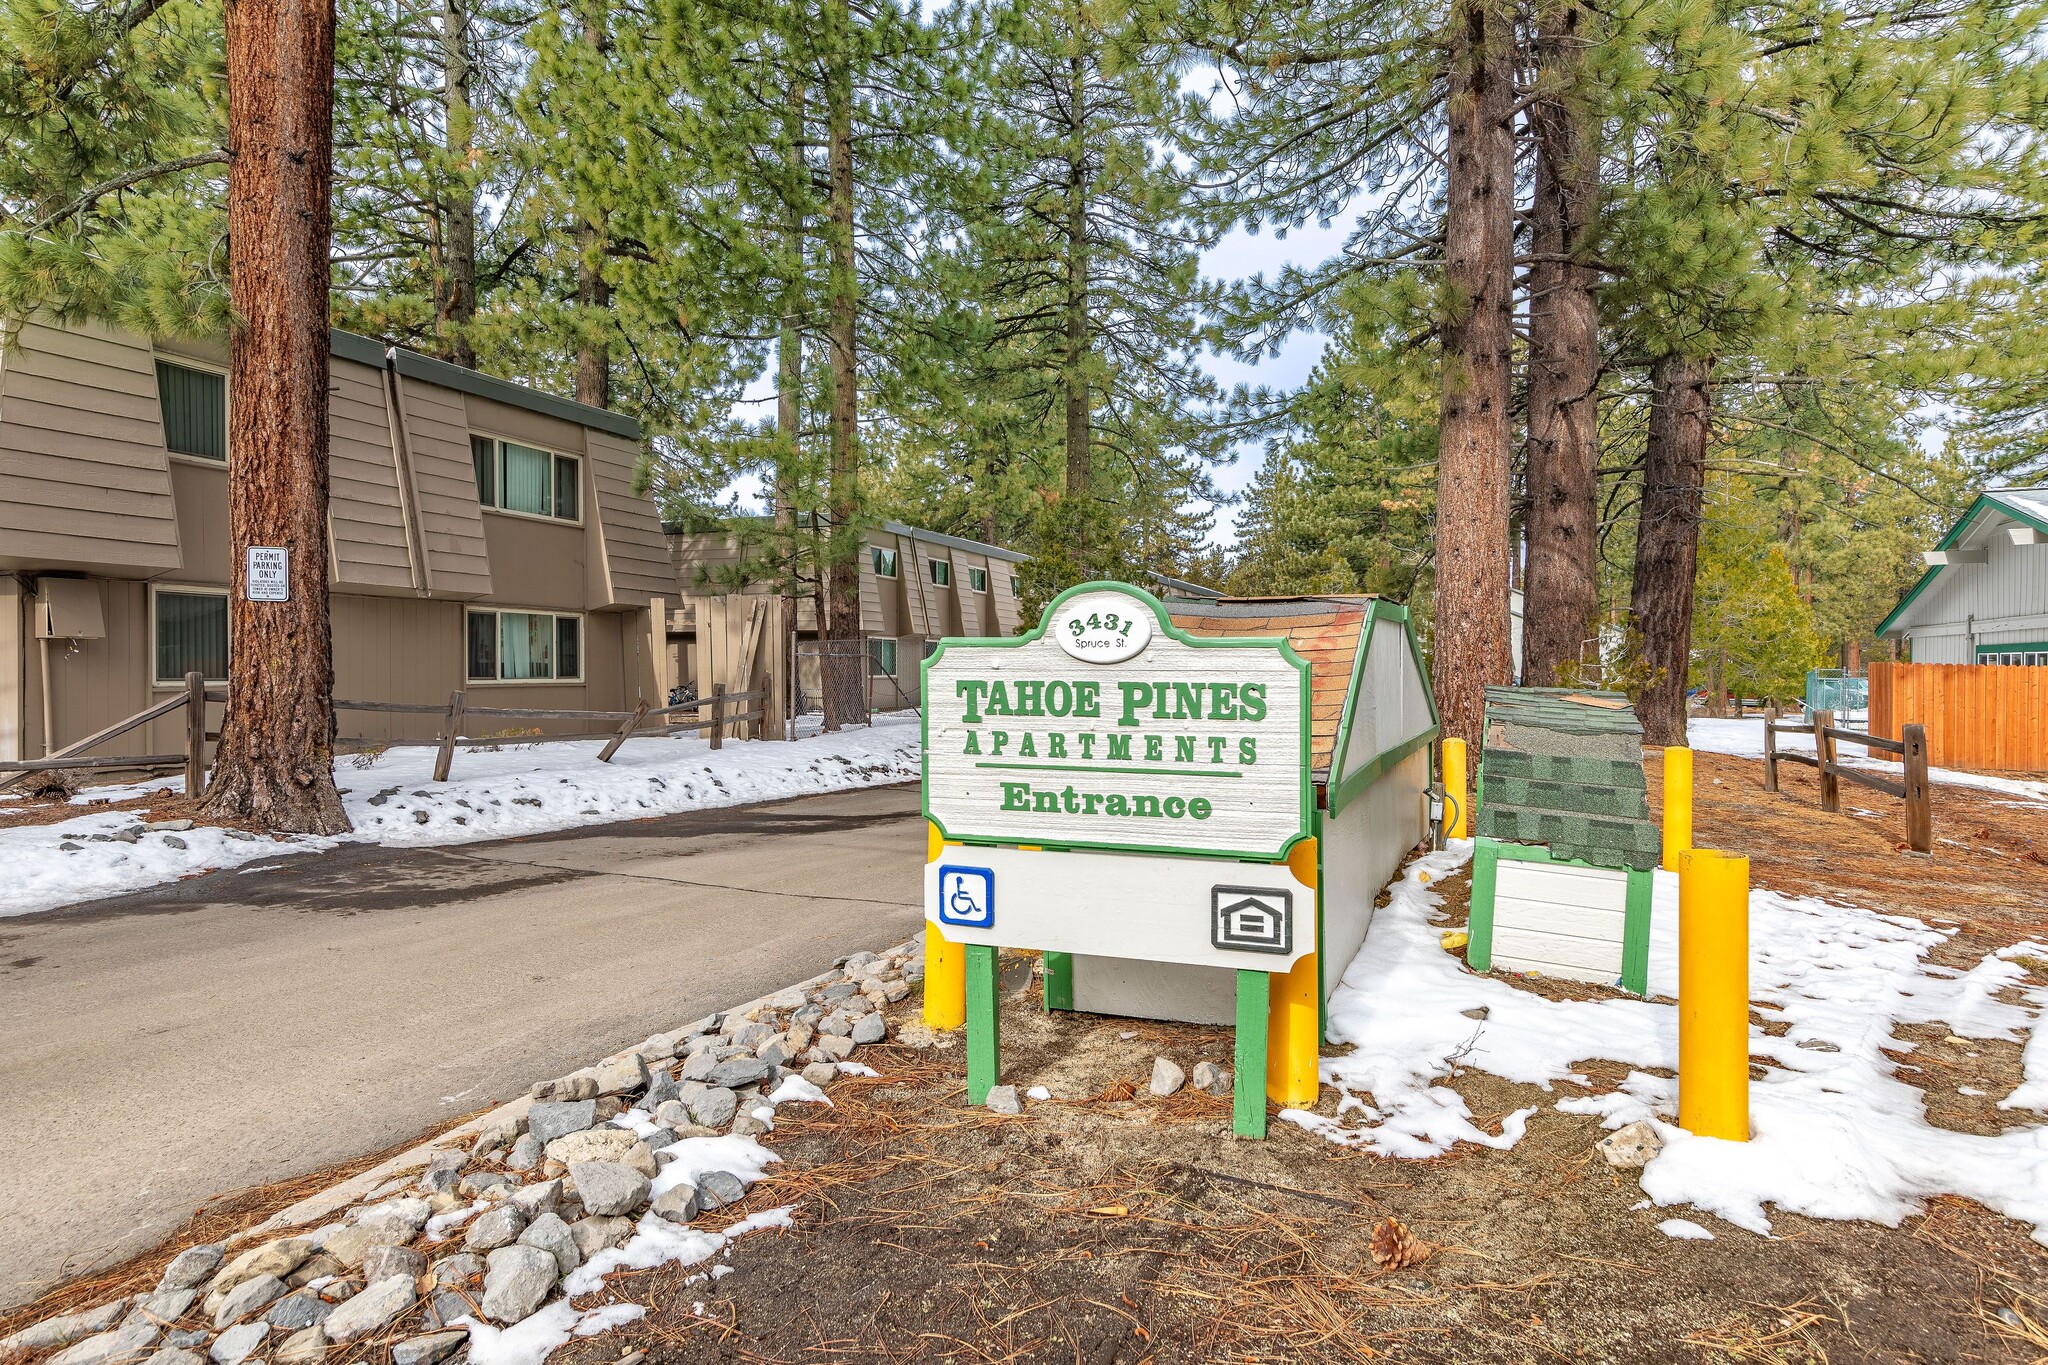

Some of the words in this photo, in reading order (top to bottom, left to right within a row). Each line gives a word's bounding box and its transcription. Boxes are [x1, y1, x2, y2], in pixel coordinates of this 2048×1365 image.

[253, 561, 282, 570] PARKING
[255, 553, 280, 561] PERMIT
[259, 570, 277, 578] ONLY
[1068, 612, 1133, 637] 3431
[1075, 638, 1110, 649] Spruce
[1115, 638, 1127, 648] St.
[956, 679, 1100, 723] TAHOE
[1117, 681, 1268, 727] PINES
[963, 730, 1258, 765] APARTMENTS
[999, 781, 1212, 819] Entrance
